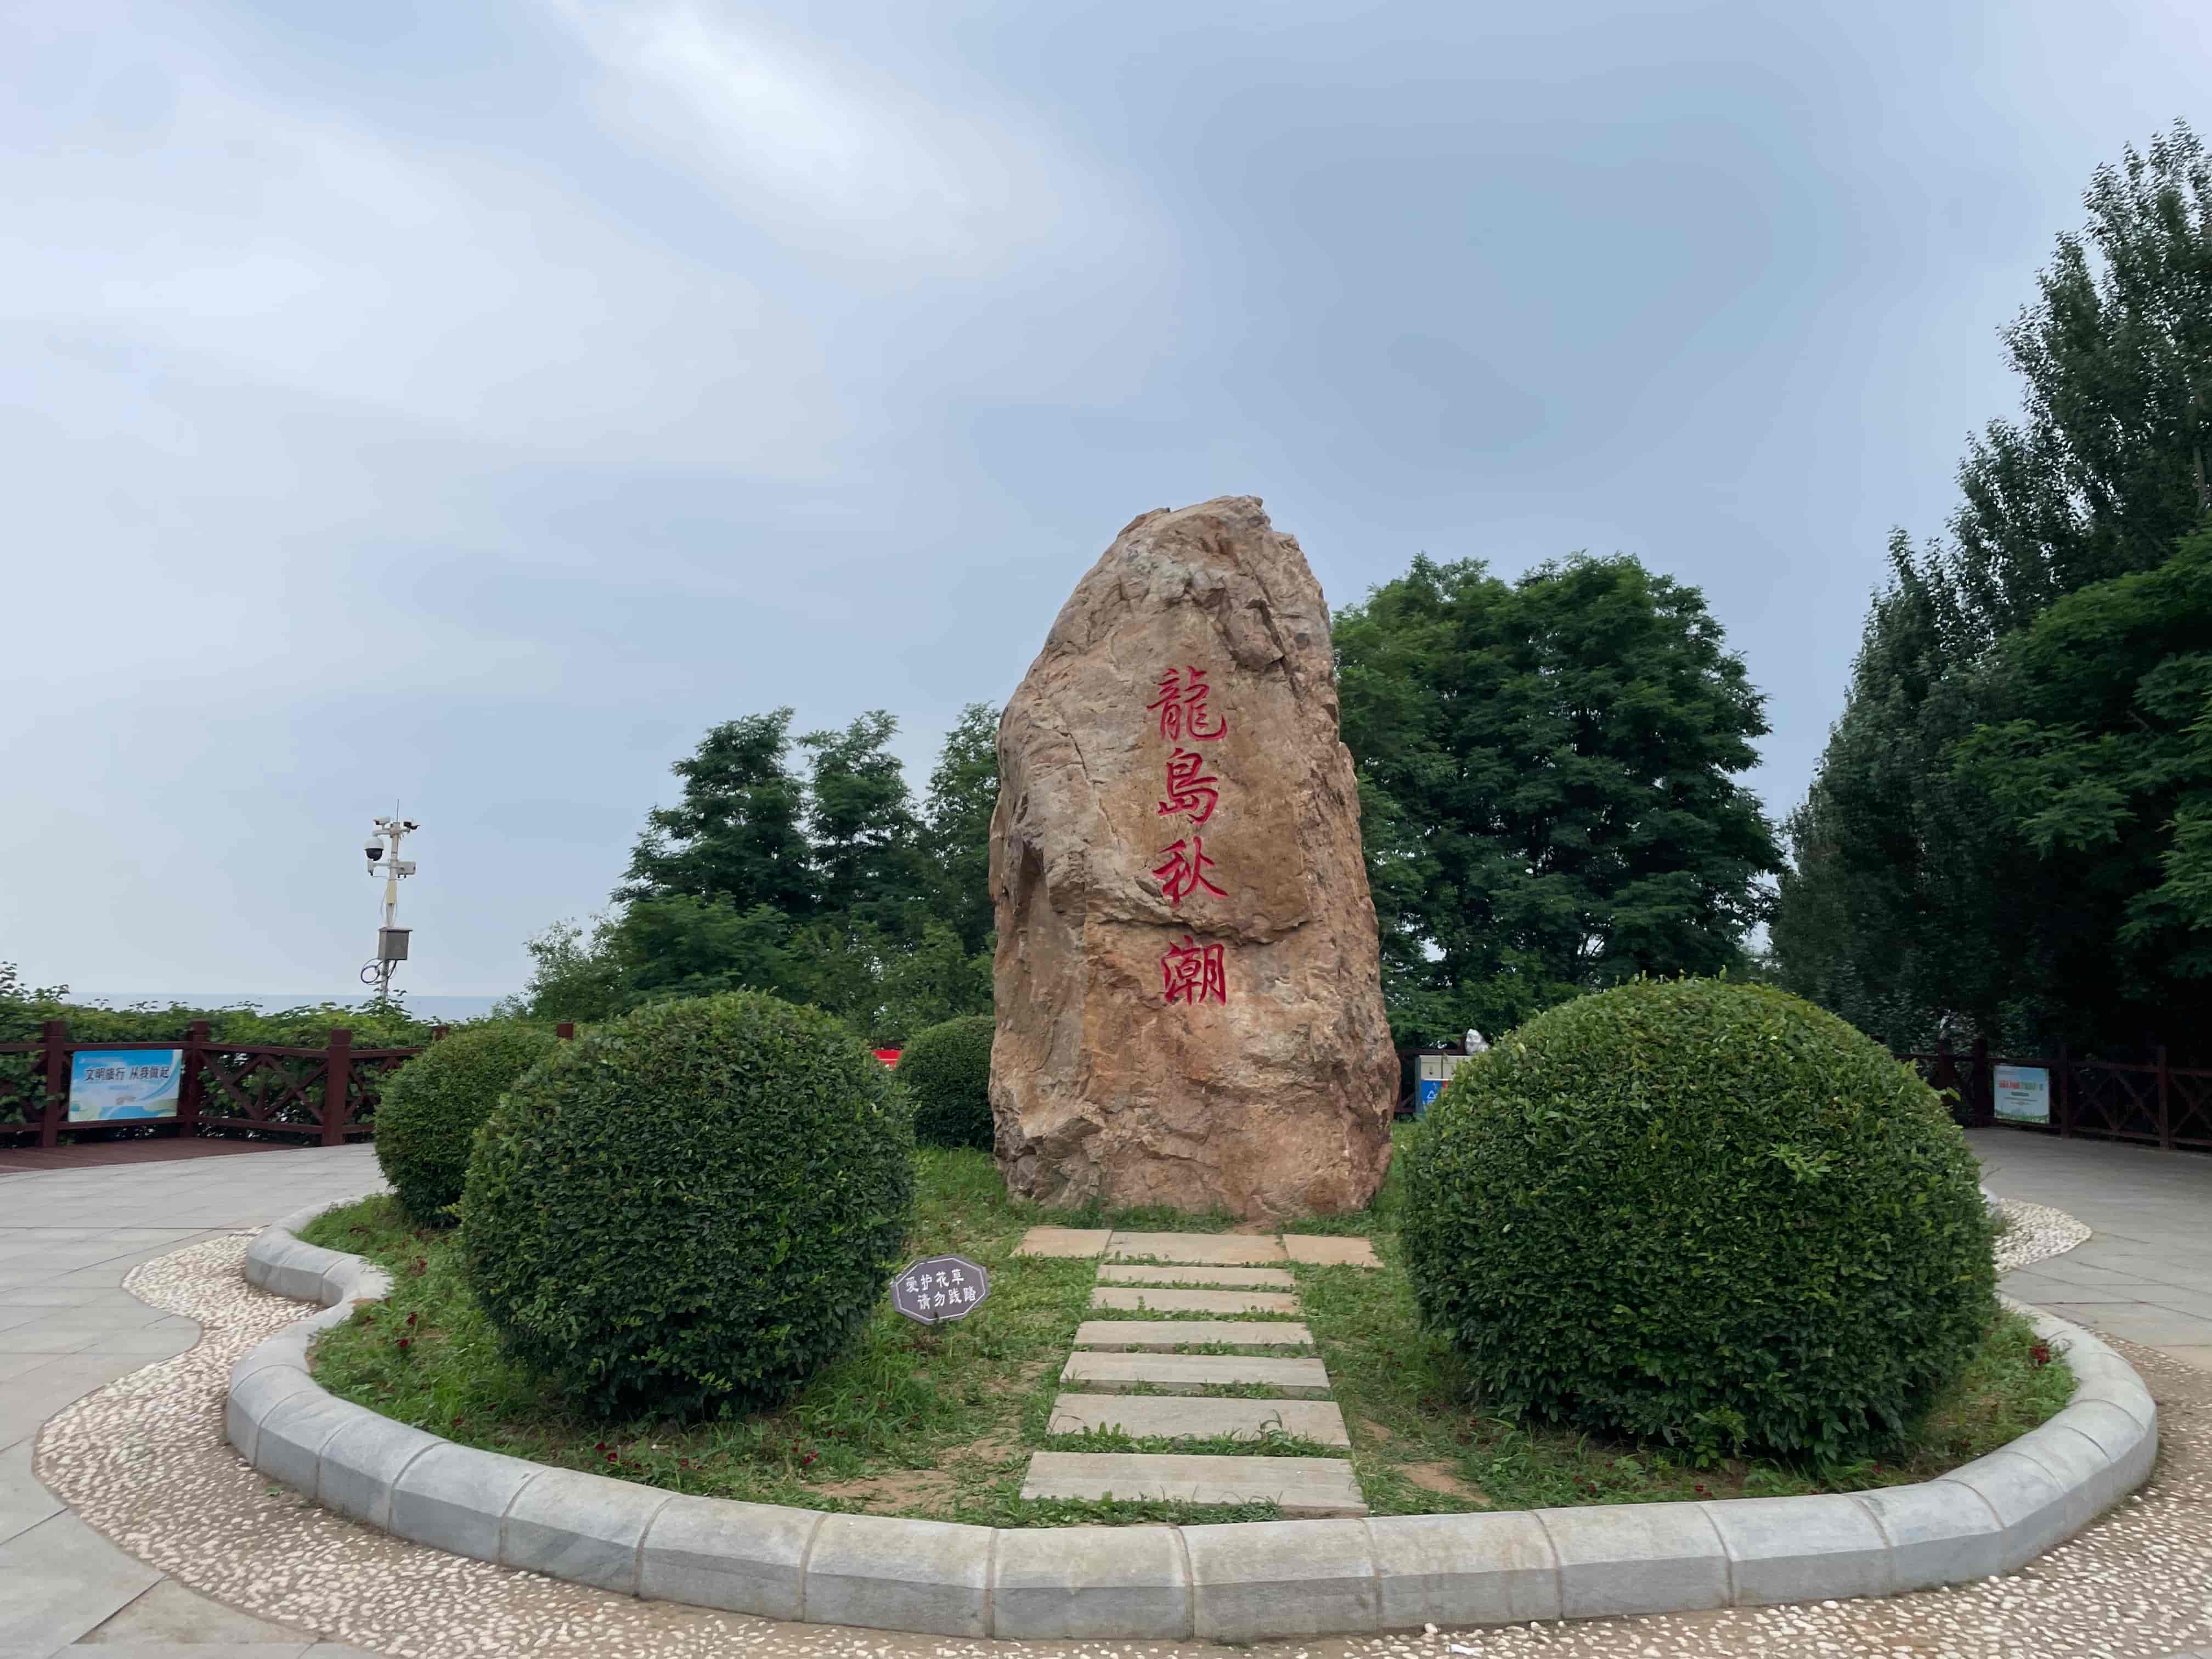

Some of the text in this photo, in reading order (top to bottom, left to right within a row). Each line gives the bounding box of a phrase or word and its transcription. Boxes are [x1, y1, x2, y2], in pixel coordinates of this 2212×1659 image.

[1147, 665, 1229, 1006] 龍島秋潮
[906, 1268, 964, 1293] 爱护花草
[917, 1285, 977, 1310] 请勿践踏
